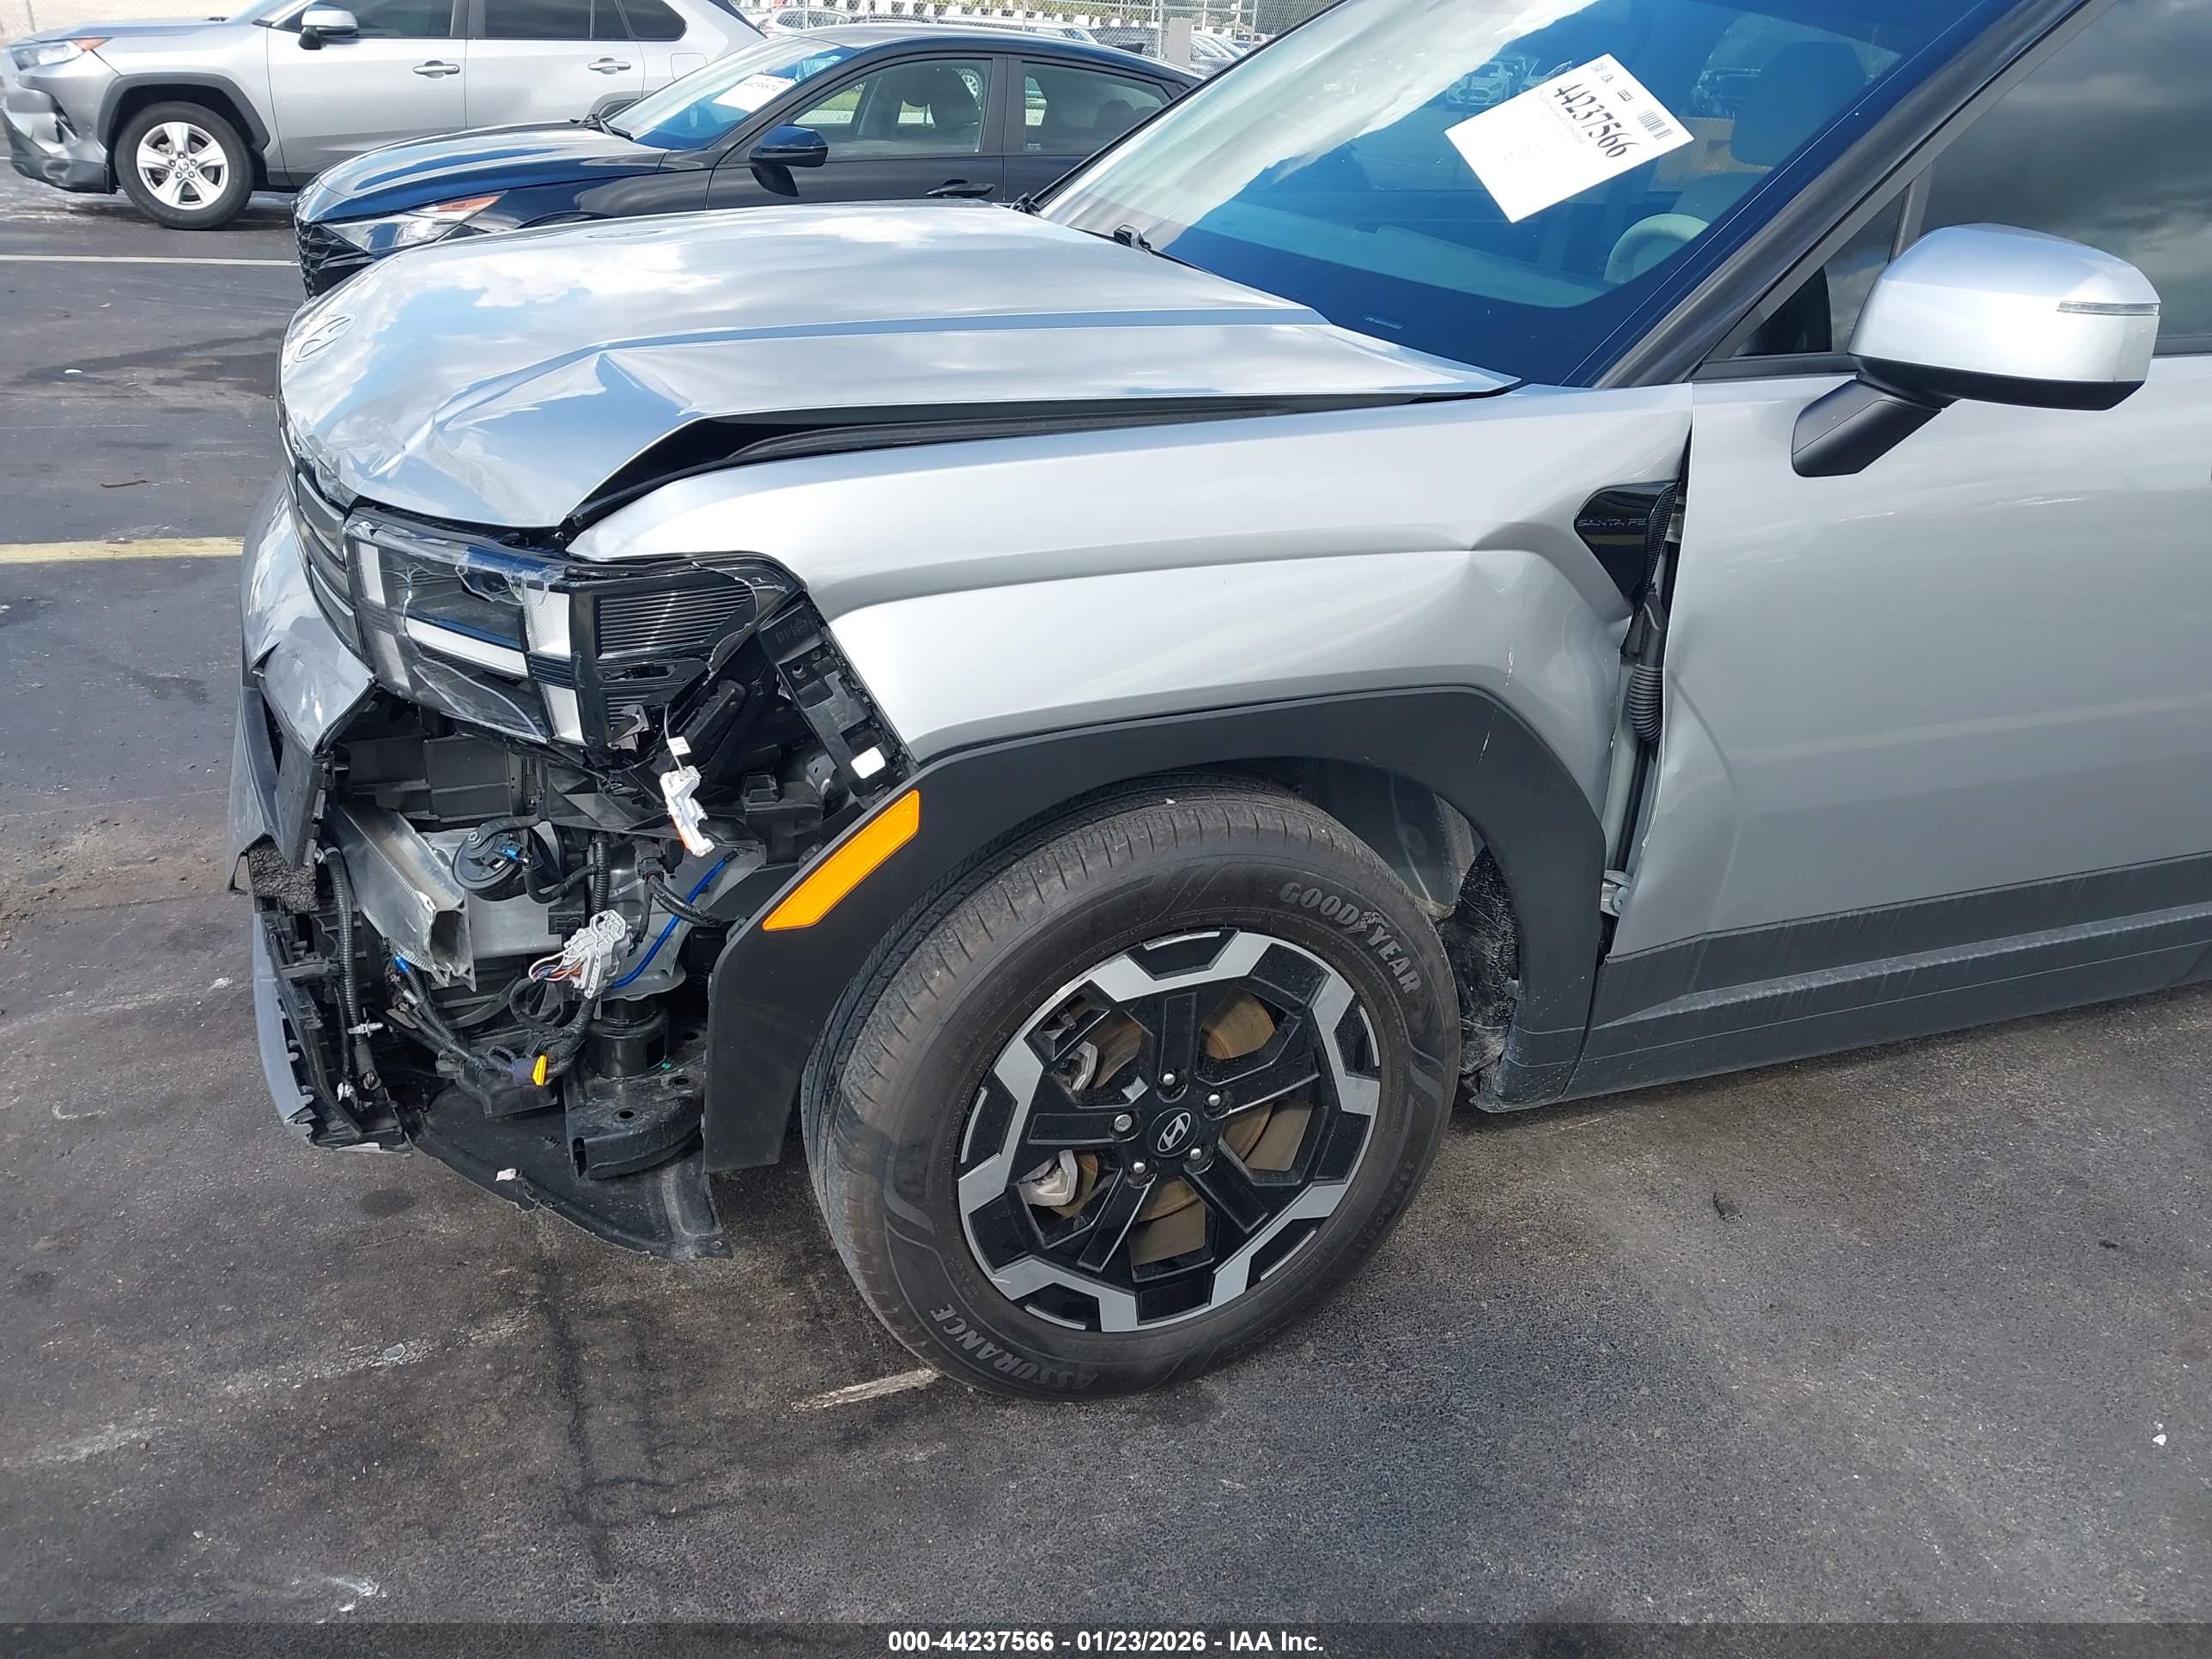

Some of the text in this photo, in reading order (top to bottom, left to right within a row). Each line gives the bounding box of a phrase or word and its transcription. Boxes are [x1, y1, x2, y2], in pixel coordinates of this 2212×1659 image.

[1553, 82, 1641, 159] 44237566
[1577, 517, 1648, 528] SANTA FE
[1279, 881, 1422, 995] GOODYEAR
[929, 1303, 1100, 1391] ASSURANCE
